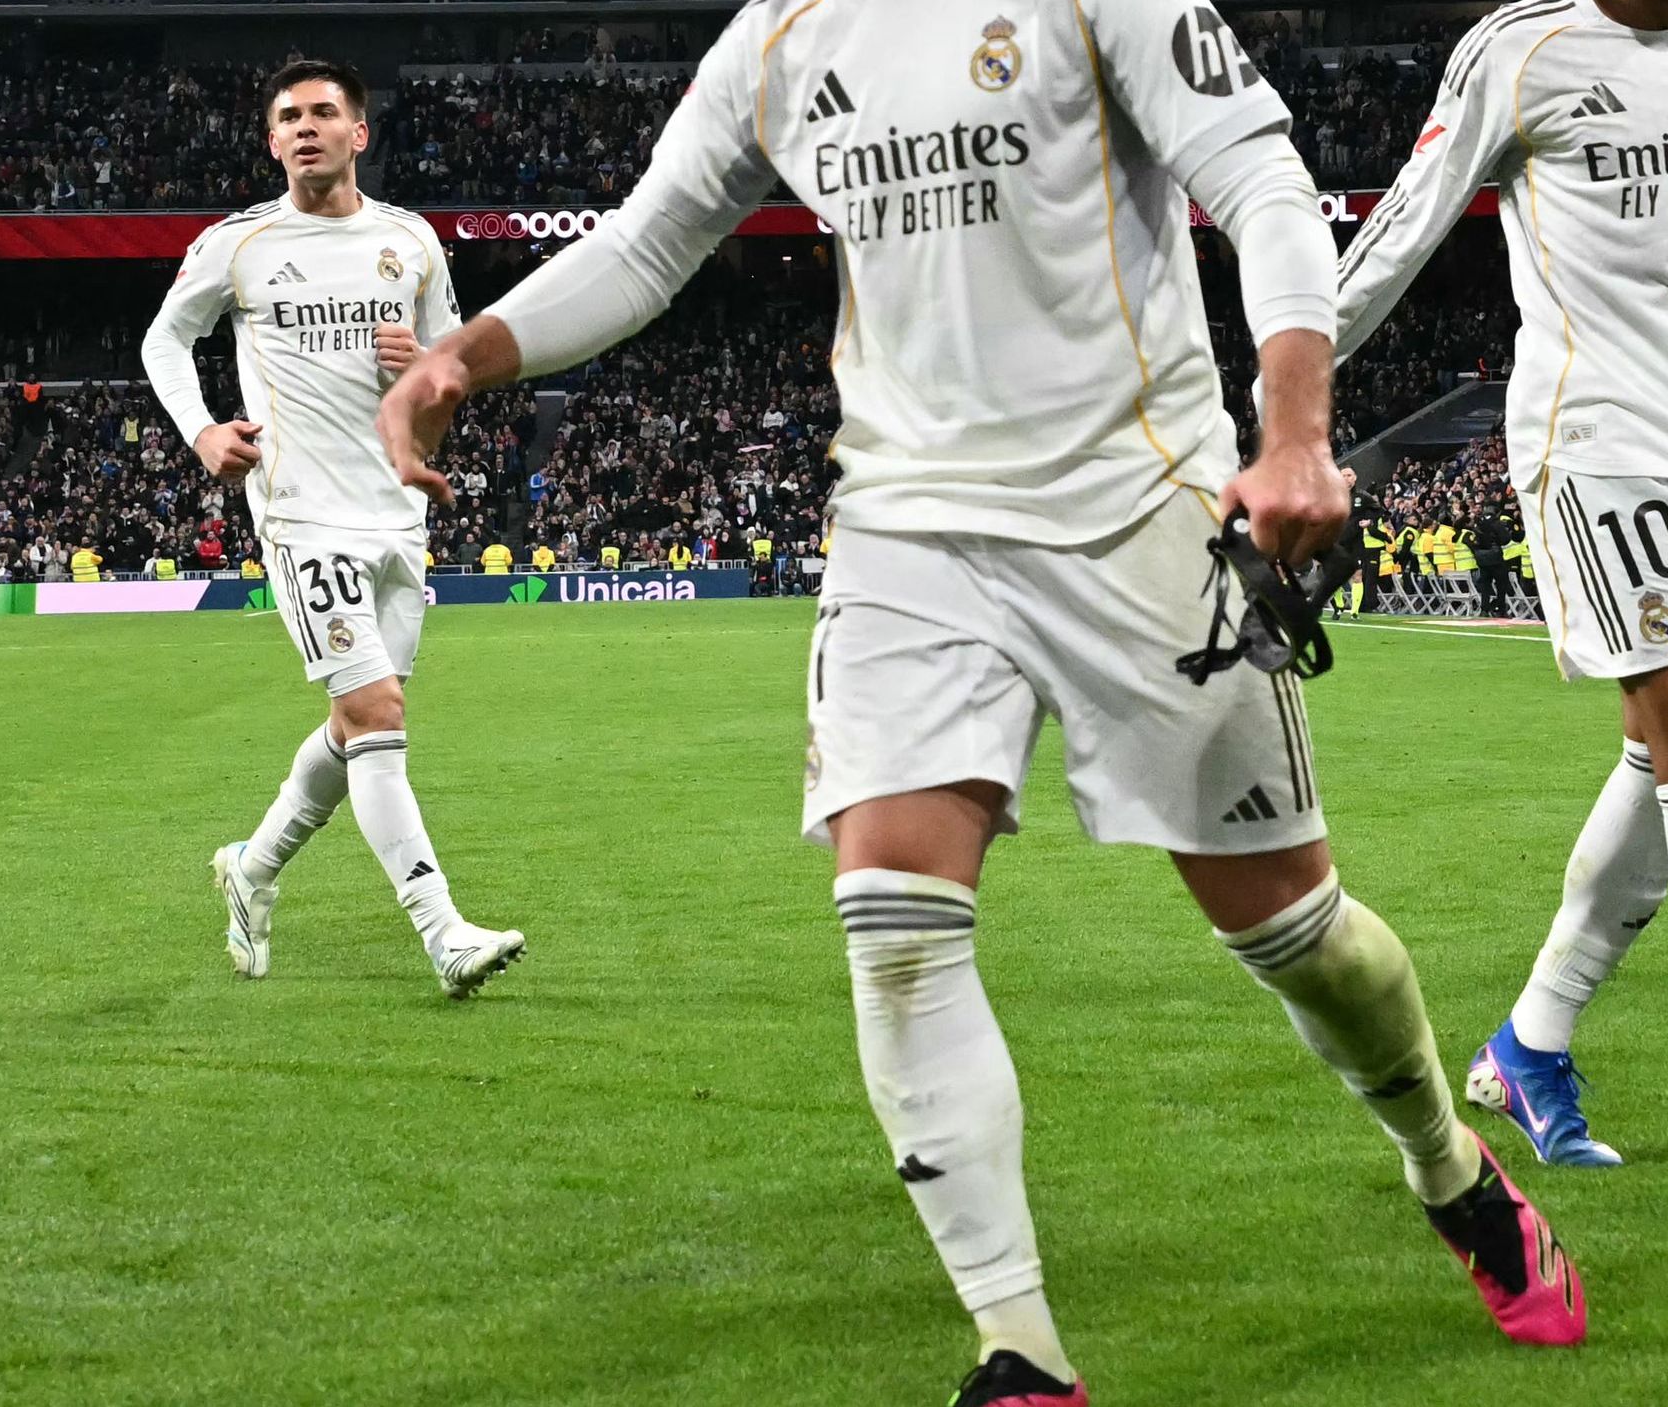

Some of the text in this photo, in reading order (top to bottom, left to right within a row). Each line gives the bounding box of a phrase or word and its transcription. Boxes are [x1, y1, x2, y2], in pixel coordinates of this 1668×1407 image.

[816, 121, 1030, 197] Emirates
[847, 179, 999, 242] FLY BETTER
[1620, 185, 1659, 219] FLY
[273, 297, 404, 329] Emirates
[299, 328, 378, 353] FLY BETTE
[299, 553, 363, 614] 30
